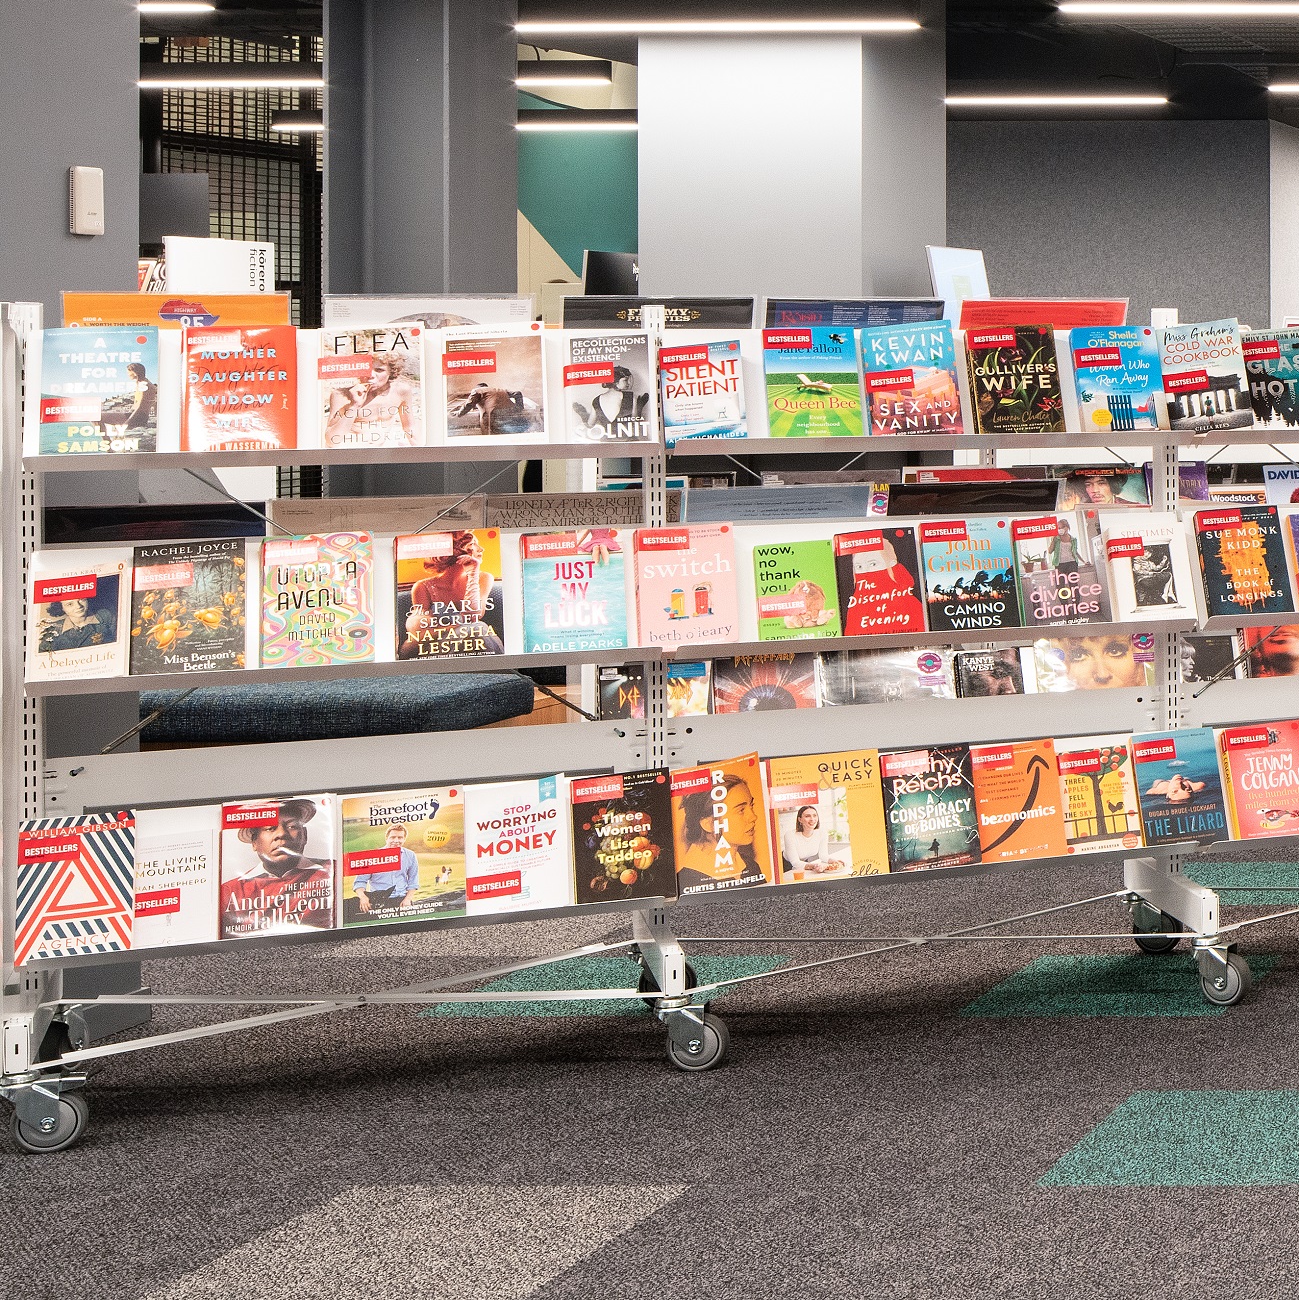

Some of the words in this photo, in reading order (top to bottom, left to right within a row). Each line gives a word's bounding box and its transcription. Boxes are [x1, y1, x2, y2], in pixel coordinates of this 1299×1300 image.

[572, 337, 646, 348] RECOLLECTIONS
[768, 336, 810, 344] BESTSELLERS
[872, 331, 945, 352] KEVIN
[973, 334, 1013, 343] BESTSELLERS
[1108, 331, 1137, 340] Sheila
[334, 332, 409, 355] FLEA
[1166, 340, 1200, 354] COLD
[1205, 336, 1233, 347] WAR
[59, 353, 141, 364] THEATRE
[572, 353, 621, 363] EXISTENCE
[875, 347, 944, 366] KWAN
[1163, 346, 1239, 365] COOKBOOK
[82, 368, 117, 378] FOR
[322, 362, 370, 372] BESTSELLERS
[975, 363, 1057, 377] GULLIVER'S
[567, 369, 611, 380] BESTSELLERS
[1168, 376, 1206, 387] BESTSELLERS
[666, 378, 739, 399] PATIENT
[982, 374, 1052, 391] WIFE
[202, 394, 274, 405] WIDOW
[773, 397, 825, 413] Queen
[829, 397, 857, 409] Bee
[333, 408, 372, 419] ACID
[380, 406, 410, 416] FOR
[809, 414, 827, 422] Every
[875, 412, 958, 431] VANITY
[67, 424, 128, 437] POLLY
[58, 438, 140, 453] SAMSON
[1211, 493, 1256, 502] Woodstock
[1203, 516, 1240, 525] BESTSELLERS
[924, 527, 965, 536] BESTSELLERS
[643, 536, 687, 544] BESTSELLERS
[1227, 539, 1261, 550] KIDD
[141, 548, 191, 558] RACHEL
[197, 542, 238, 554] JOYCE
[758, 546, 795, 556] wow,
[644, 553, 732, 579] switch
[927, 554, 1012, 573] Grisham
[554, 561, 595, 581] JUST
[760, 569, 801, 581] thank
[1236, 567, 1260, 576] THE
[1048, 570, 1080, 587] the
[43, 583, 94, 595] BESTSELLERS
[1030, 582, 1101, 604] divorce
[1220, 590, 1283, 603] LONGINGS
[544, 600, 608, 628] LUCK
[944, 601, 1005, 617] CAMINO
[1034, 600, 1100, 621] diaries
[300, 612, 336, 626] DAVID
[419, 614, 482, 629] SECRET
[860, 614, 910, 629] Evening
[951, 615, 1002, 629] WINDS
[288, 627, 347, 641] MITCHELL
[406, 625, 497, 644] NATASHA
[418, 640, 486, 656] LESTER
[39, 661, 47, 670] A
[50, 657, 93, 669] Delayed
[95, 652, 116, 663] Life
[963, 657, 994, 665] KANYE
[969, 664, 994, 672] WEST
[619, 685, 640, 709] DEF
[1230, 734, 1267, 745] BESTSELLERS
[818, 758, 873, 773] QUICK
[1059, 758, 1099, 769] BESTSELLERS
[1246, 753, 1293, 775] JENNY
[833, 769, 873, 784] EASY
[226, 810, 277, 821] BESTSELLERS
[369, 801, 429, 817] barefoot
[503, 804, 531, 815] STOP
[980, 805, 1056, 826] bezonomics
[370, 811, 426, 827] investor
[477, 809, 557, 831] WORRYING
[601, 811, 643, 825] Three
[29, 826, 78, 838] WILLIAM
[82, 821, 128, 833] GIBSON
[499, 825, 536, 838] ABOUT
[594, 822, 651, 838] Women
[1145, 819, 1173, 838] THE
[1177, 813, 1224, 833] LIZARD
[426, 834, 445, 842] 2019
[477, 829, 556, 859] MONEY
[610, 839, 638, 850] Lisa
[597, 850, 652, 865] Taddeo
[472, 879, 519, 893] BESTSELLERS
[683, 882, 715, 894] CURTIS
[716, 873, 766, 890] SITTENFELD
[37, 932, 110, 952] AGENCY
